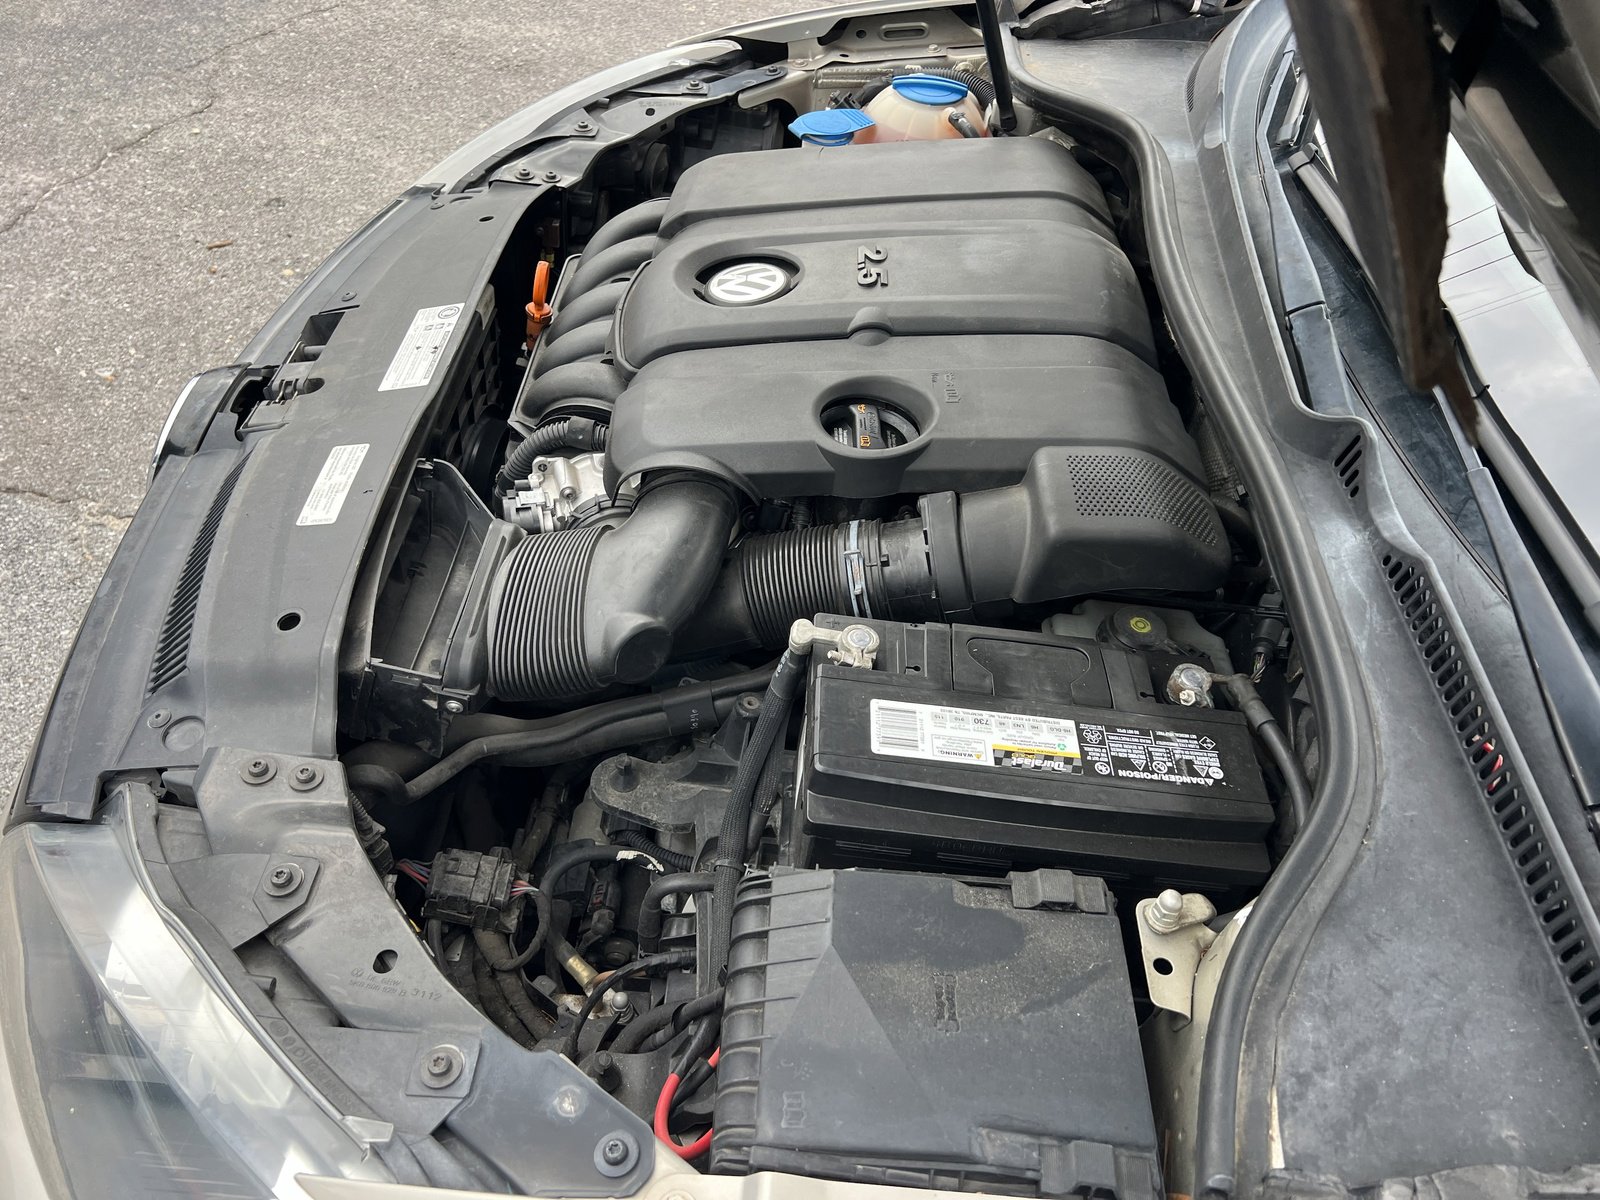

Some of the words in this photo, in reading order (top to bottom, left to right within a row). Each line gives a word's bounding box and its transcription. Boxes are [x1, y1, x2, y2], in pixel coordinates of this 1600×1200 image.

[857, 245, 888, 287] 2.5
[973, 717, 989, 725] 730
[1011, 756, 1063, 770] Duralast
[1118, 770, 1204, 784] DANGER/POISON
